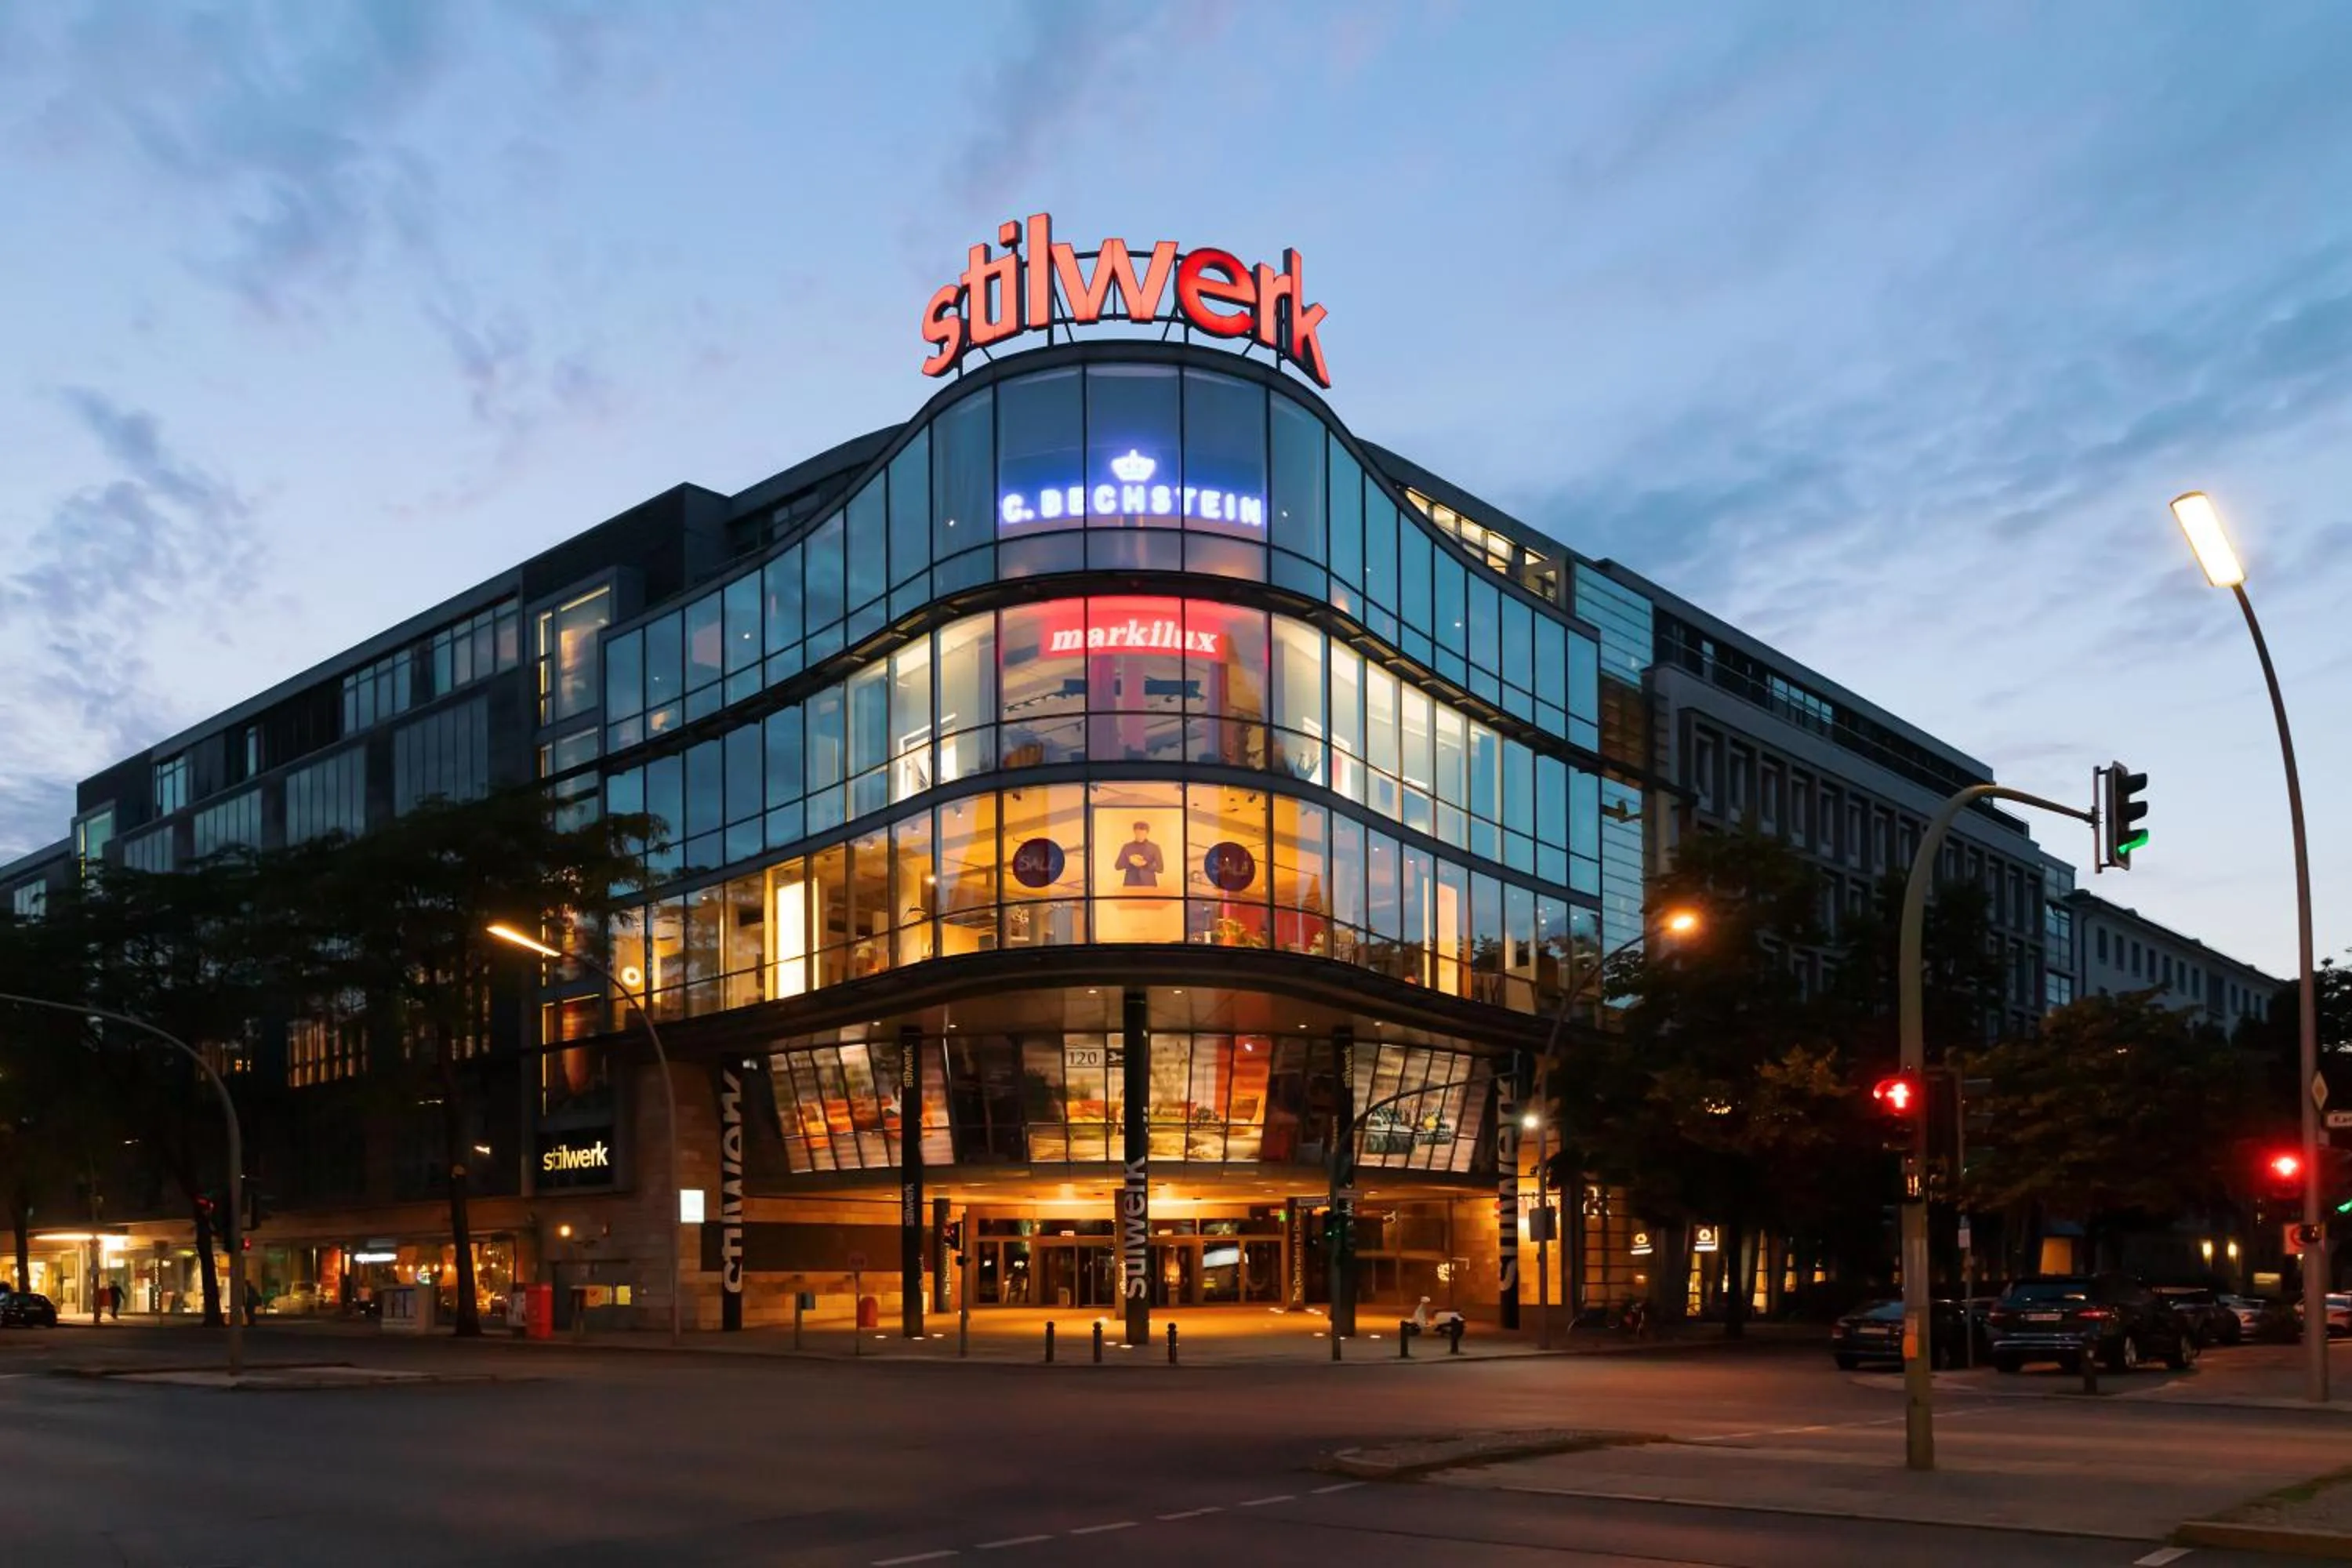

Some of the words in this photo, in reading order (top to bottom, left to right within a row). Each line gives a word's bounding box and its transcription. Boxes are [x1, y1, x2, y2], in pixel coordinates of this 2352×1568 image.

[921, 212, 1331, 389] stilwerk
[1050, 619, 1217, 653] markilux
[1069, 1051, 1097, 1065] 120
[543, 1141, 609, 1171] stilwerk
